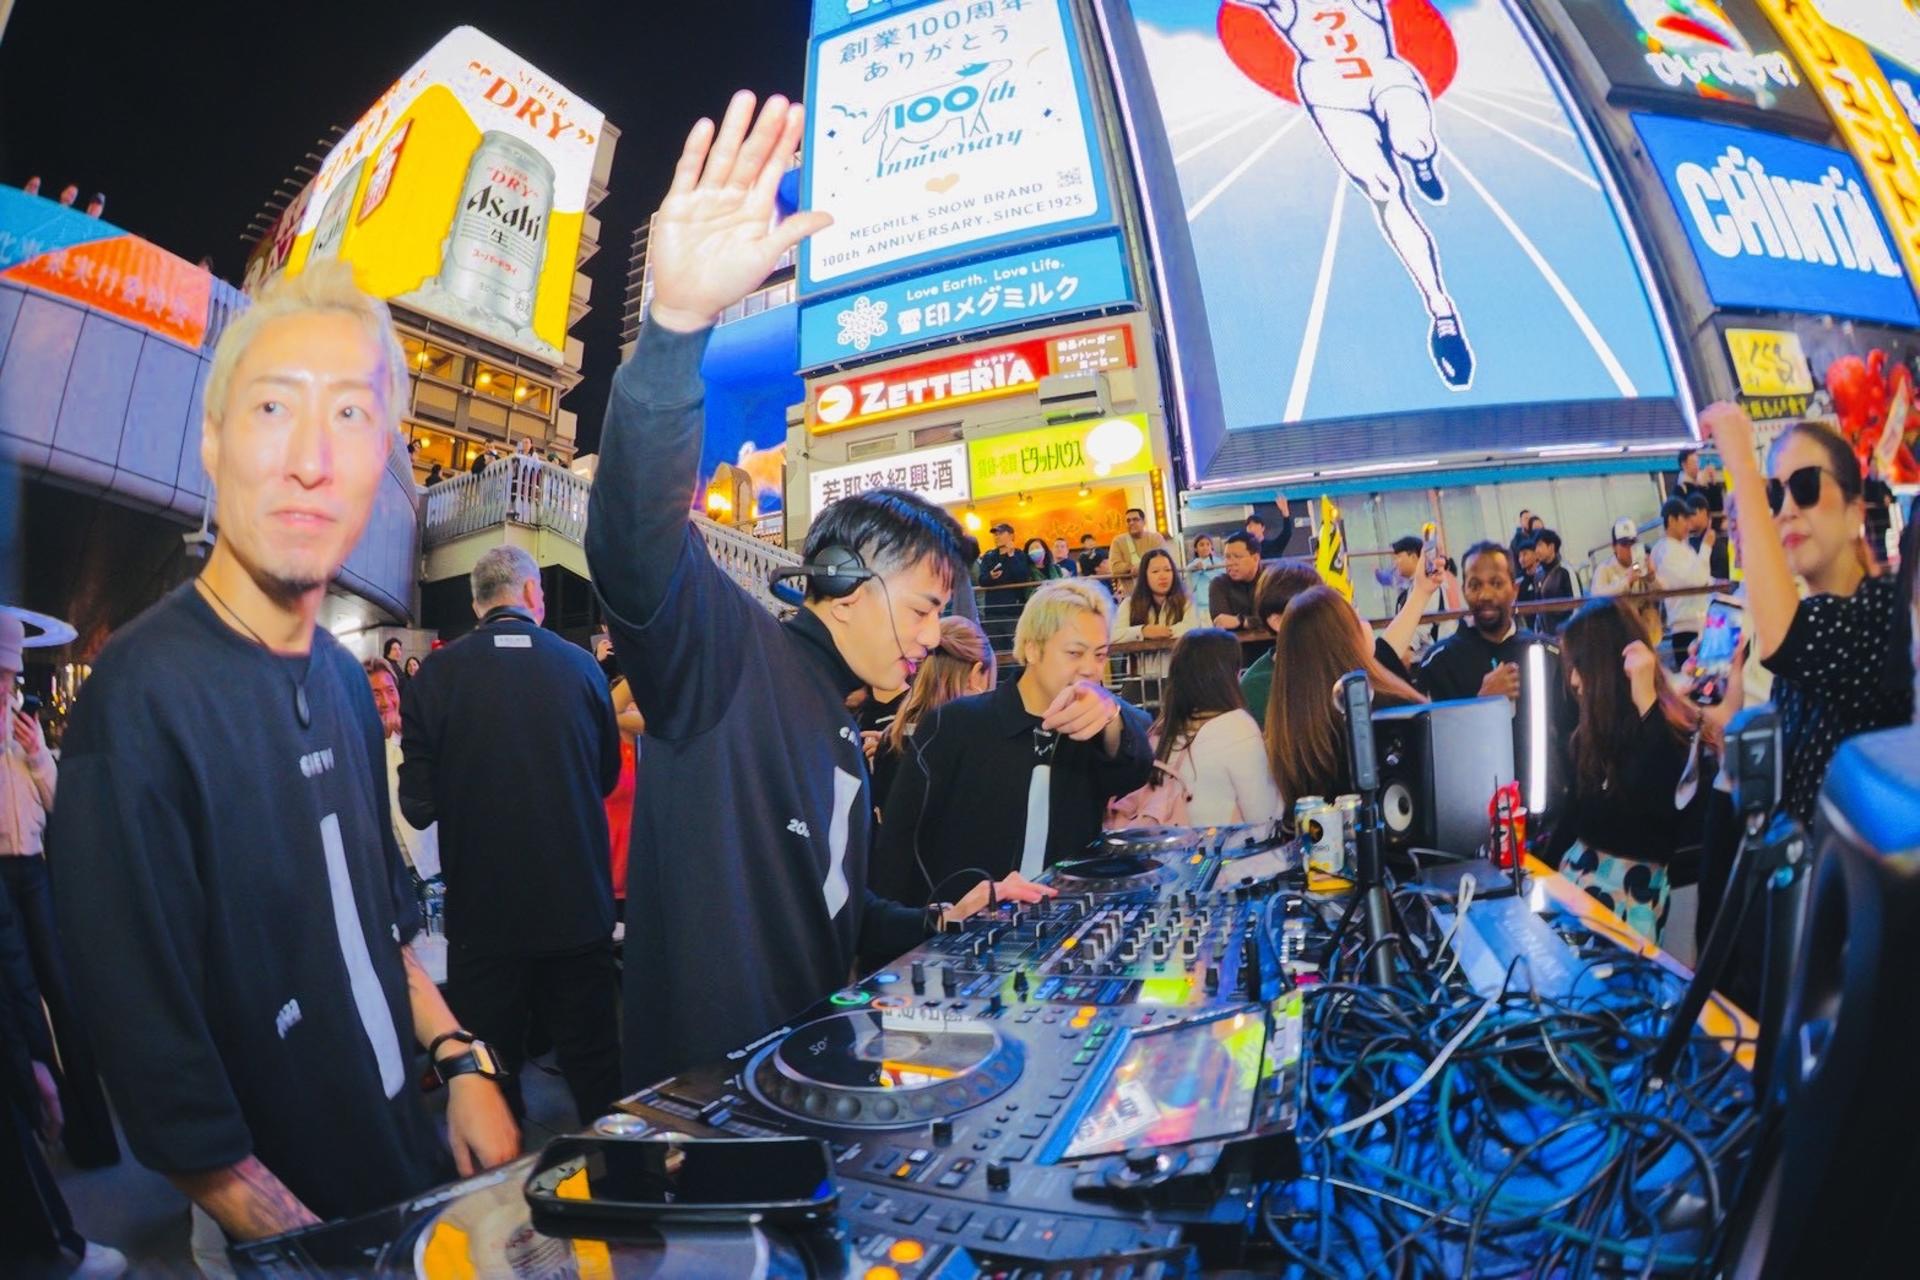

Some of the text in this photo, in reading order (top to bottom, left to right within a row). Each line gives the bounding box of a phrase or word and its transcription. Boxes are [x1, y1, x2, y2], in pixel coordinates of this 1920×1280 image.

[864, 24, 1009, 82] ありがとう
[467, 185, 541, 241] Asahi
[850, 182, 1042, 240] MEGMILK SNOW BRAND
[906, 258, 1065, 301] Love Earth. Love Life.
[860, 358, 1036, 415] ZETTERIA
[1021, 440, 1085, 475] ピタットハウス
